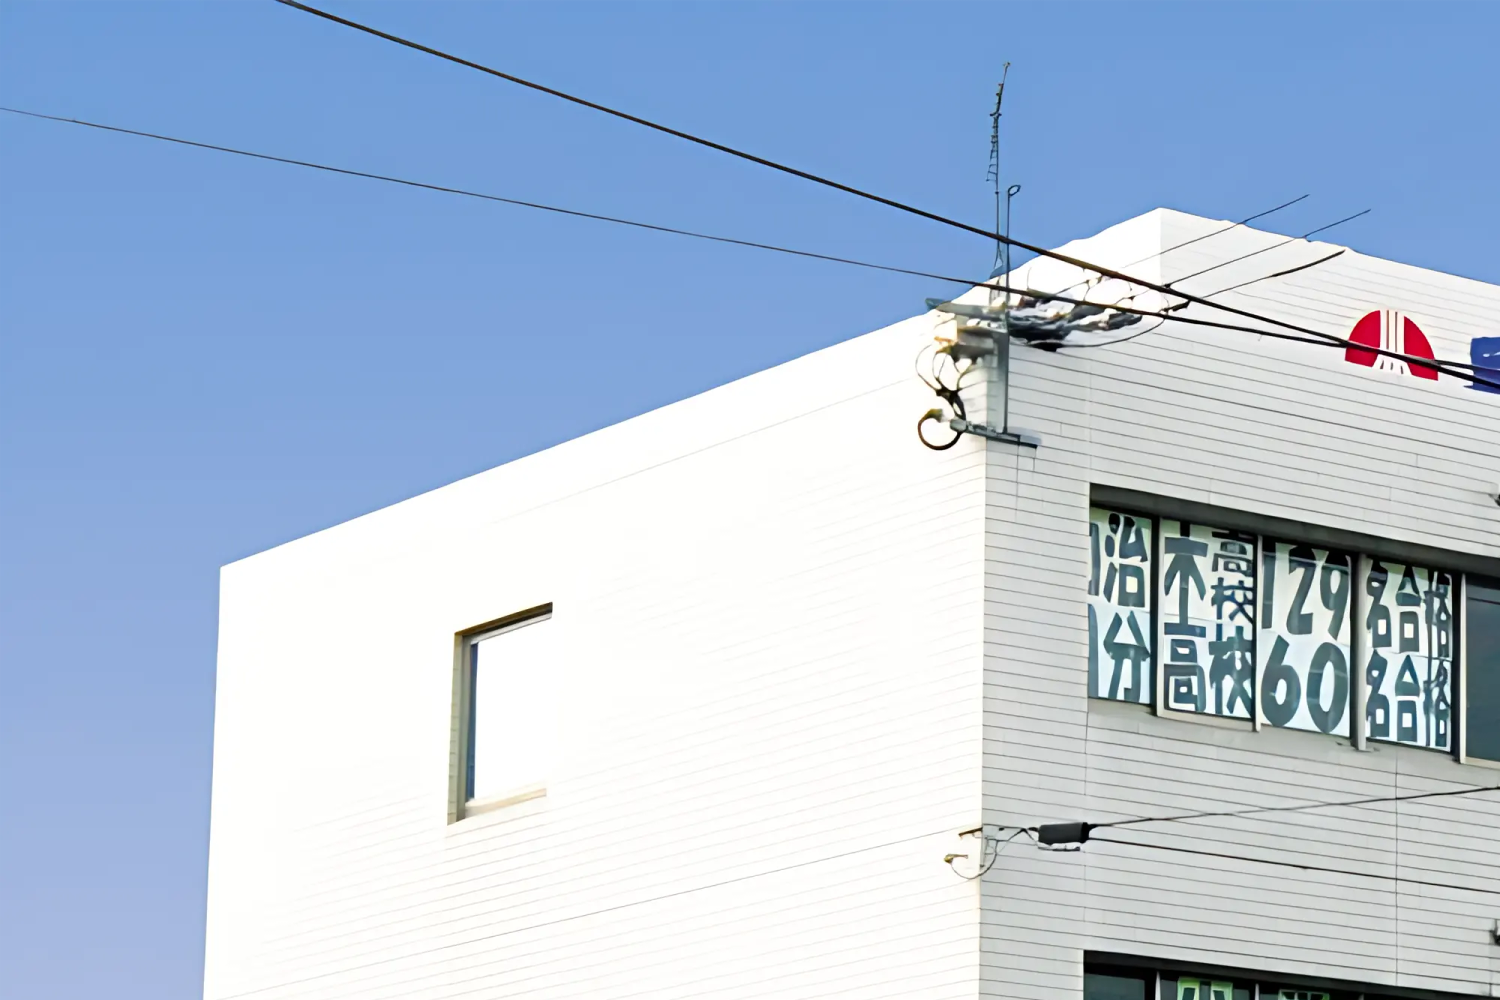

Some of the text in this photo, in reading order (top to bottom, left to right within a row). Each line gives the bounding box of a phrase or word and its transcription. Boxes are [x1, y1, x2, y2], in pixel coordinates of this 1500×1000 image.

[1088, 512, 1452, 662] 治木高校129名合格
[1088, 604, 1452, 748] 分高校60名合格
